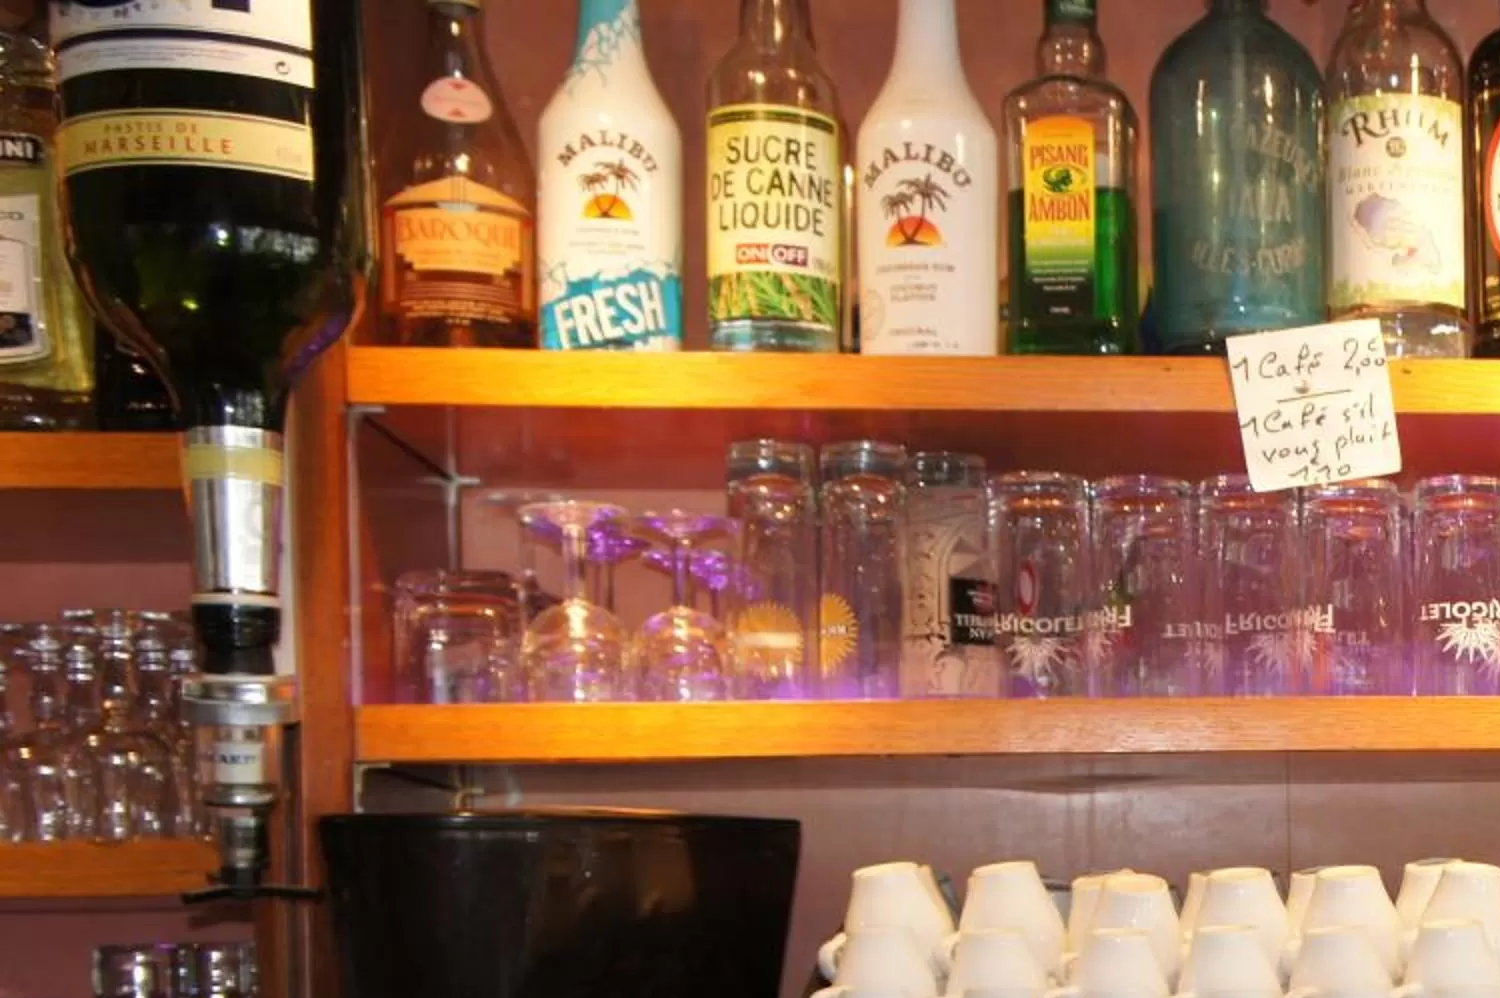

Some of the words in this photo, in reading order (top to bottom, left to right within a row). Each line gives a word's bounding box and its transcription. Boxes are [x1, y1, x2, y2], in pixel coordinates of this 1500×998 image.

[83, 135, 233, 155] MARSEILLE
[102, 121, 163, 134] PASTIS
[556, 130, 660, 175] MALIBU
[725, 135, 817, 171] SUCRE
[863, 141, 972, 190] MALIBU
[1029, 143, 1089, 171] PISANG
[711, 170, 736, 201] DE
[745, 166, 833, 209] CANNE
[718, 200, 825, 238] LIQUIDE
[554, 279, 666, 350] FRESH
[1232, 357, 1250, 383] 1
[1258, 343, 1325, 379] Café
[1240, 416, 1260, 438] 1
[1263, 403, 1329, 434] Café
